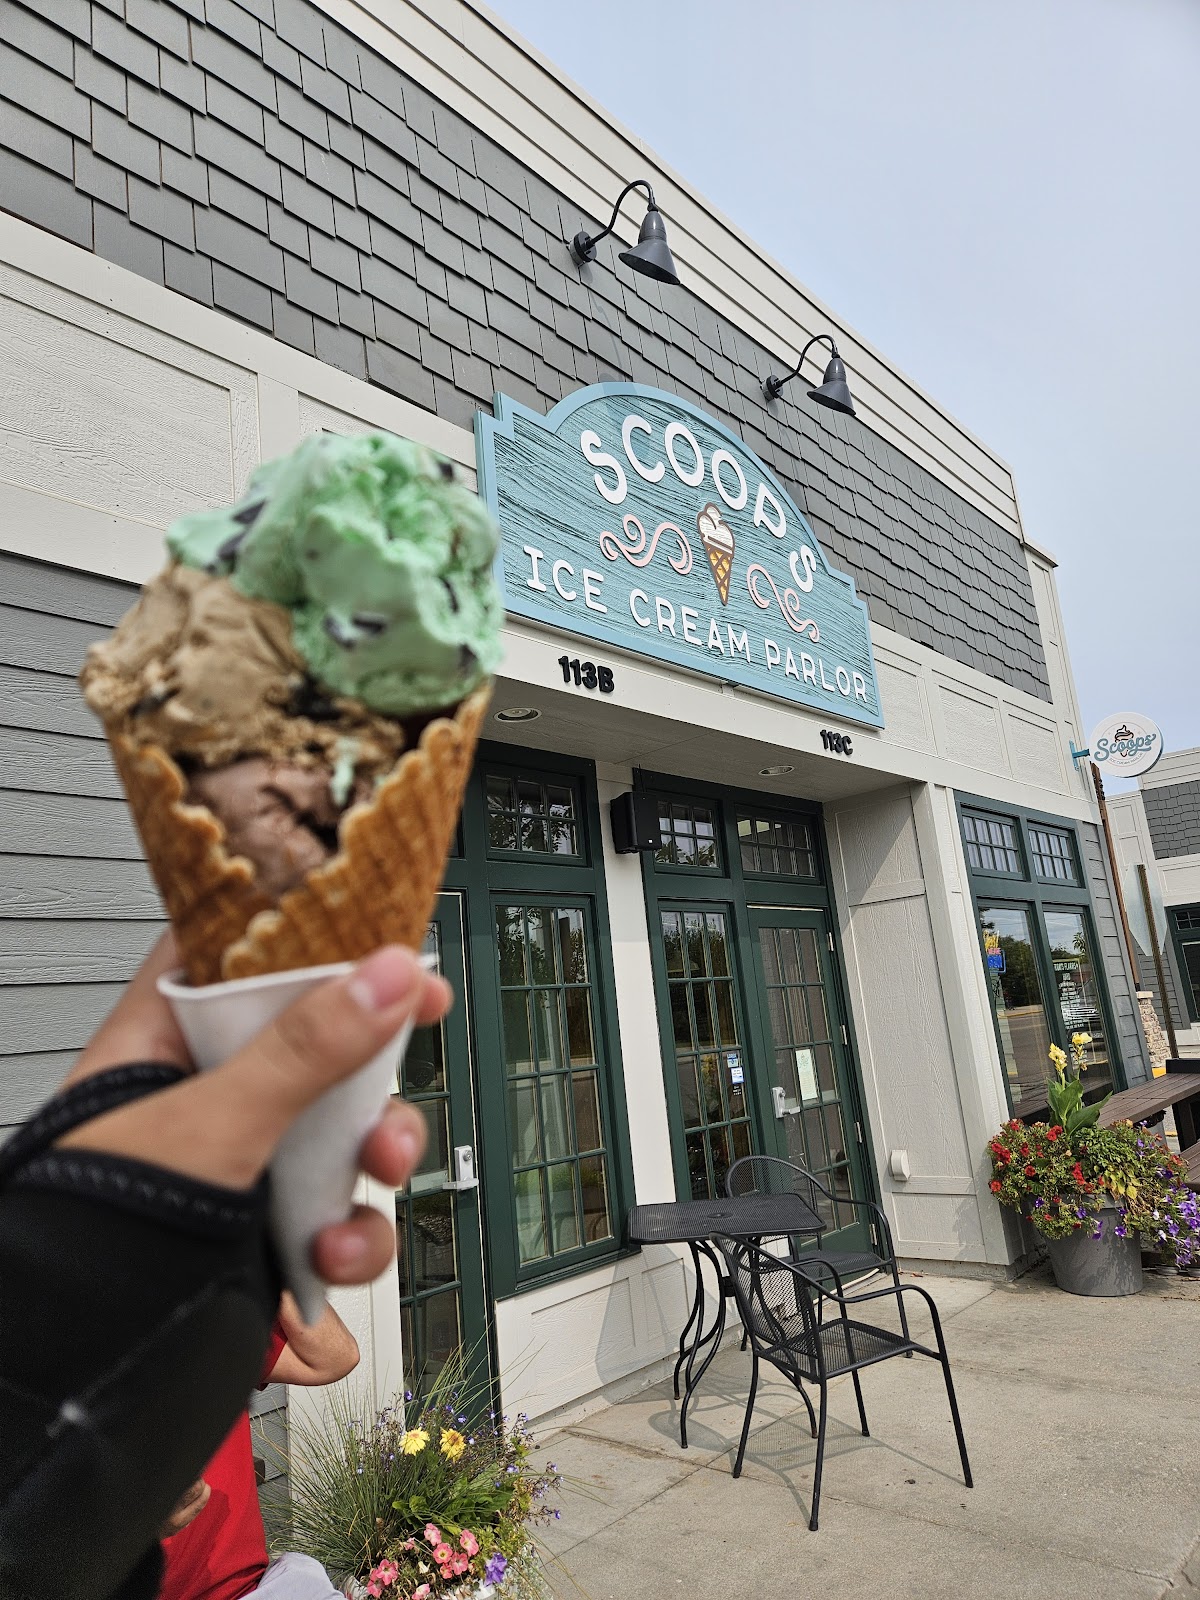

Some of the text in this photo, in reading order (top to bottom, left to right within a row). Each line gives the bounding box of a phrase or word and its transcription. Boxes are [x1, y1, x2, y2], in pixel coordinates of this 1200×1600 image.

[580, 414, 816, 593] SCOOPS
[523, 545, 867, 702] ICE CREAM PARLOR
[558, 656, 615, 693] 113B
[819, 729, 853, 756] 113C
[1094, 733, 1157, 761] Scoops
